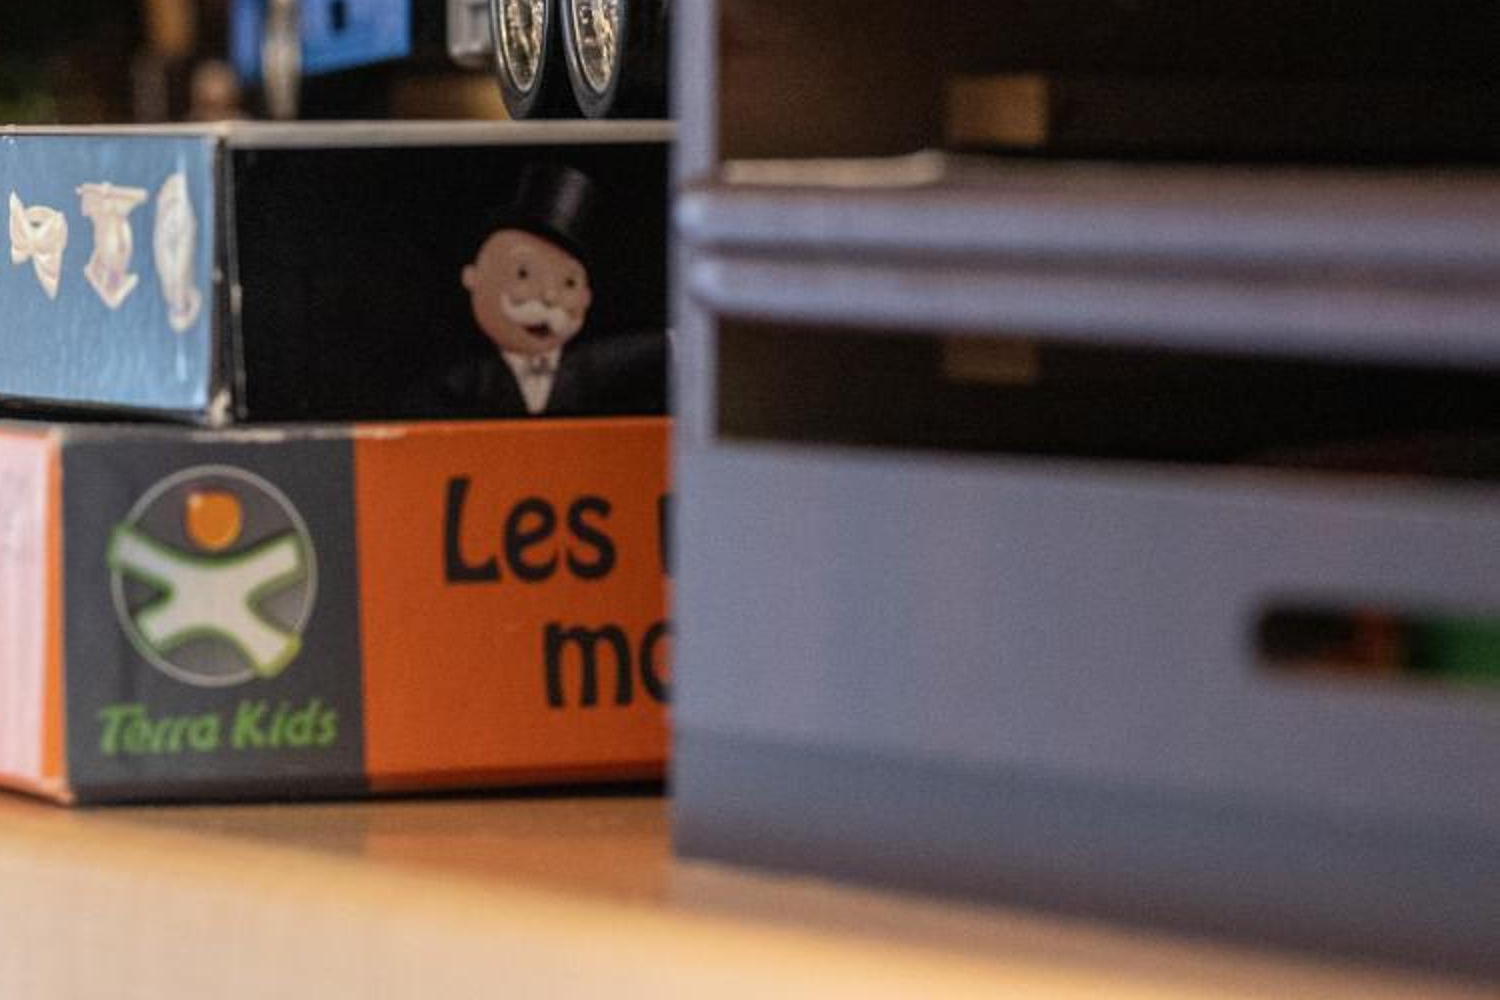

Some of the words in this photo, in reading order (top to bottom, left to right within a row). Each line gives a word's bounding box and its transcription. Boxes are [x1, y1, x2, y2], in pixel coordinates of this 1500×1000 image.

[443, 476, 617, 584] Les
[97, 702, 220, 756] Terra
[230, 696, 339, 751] Kids
